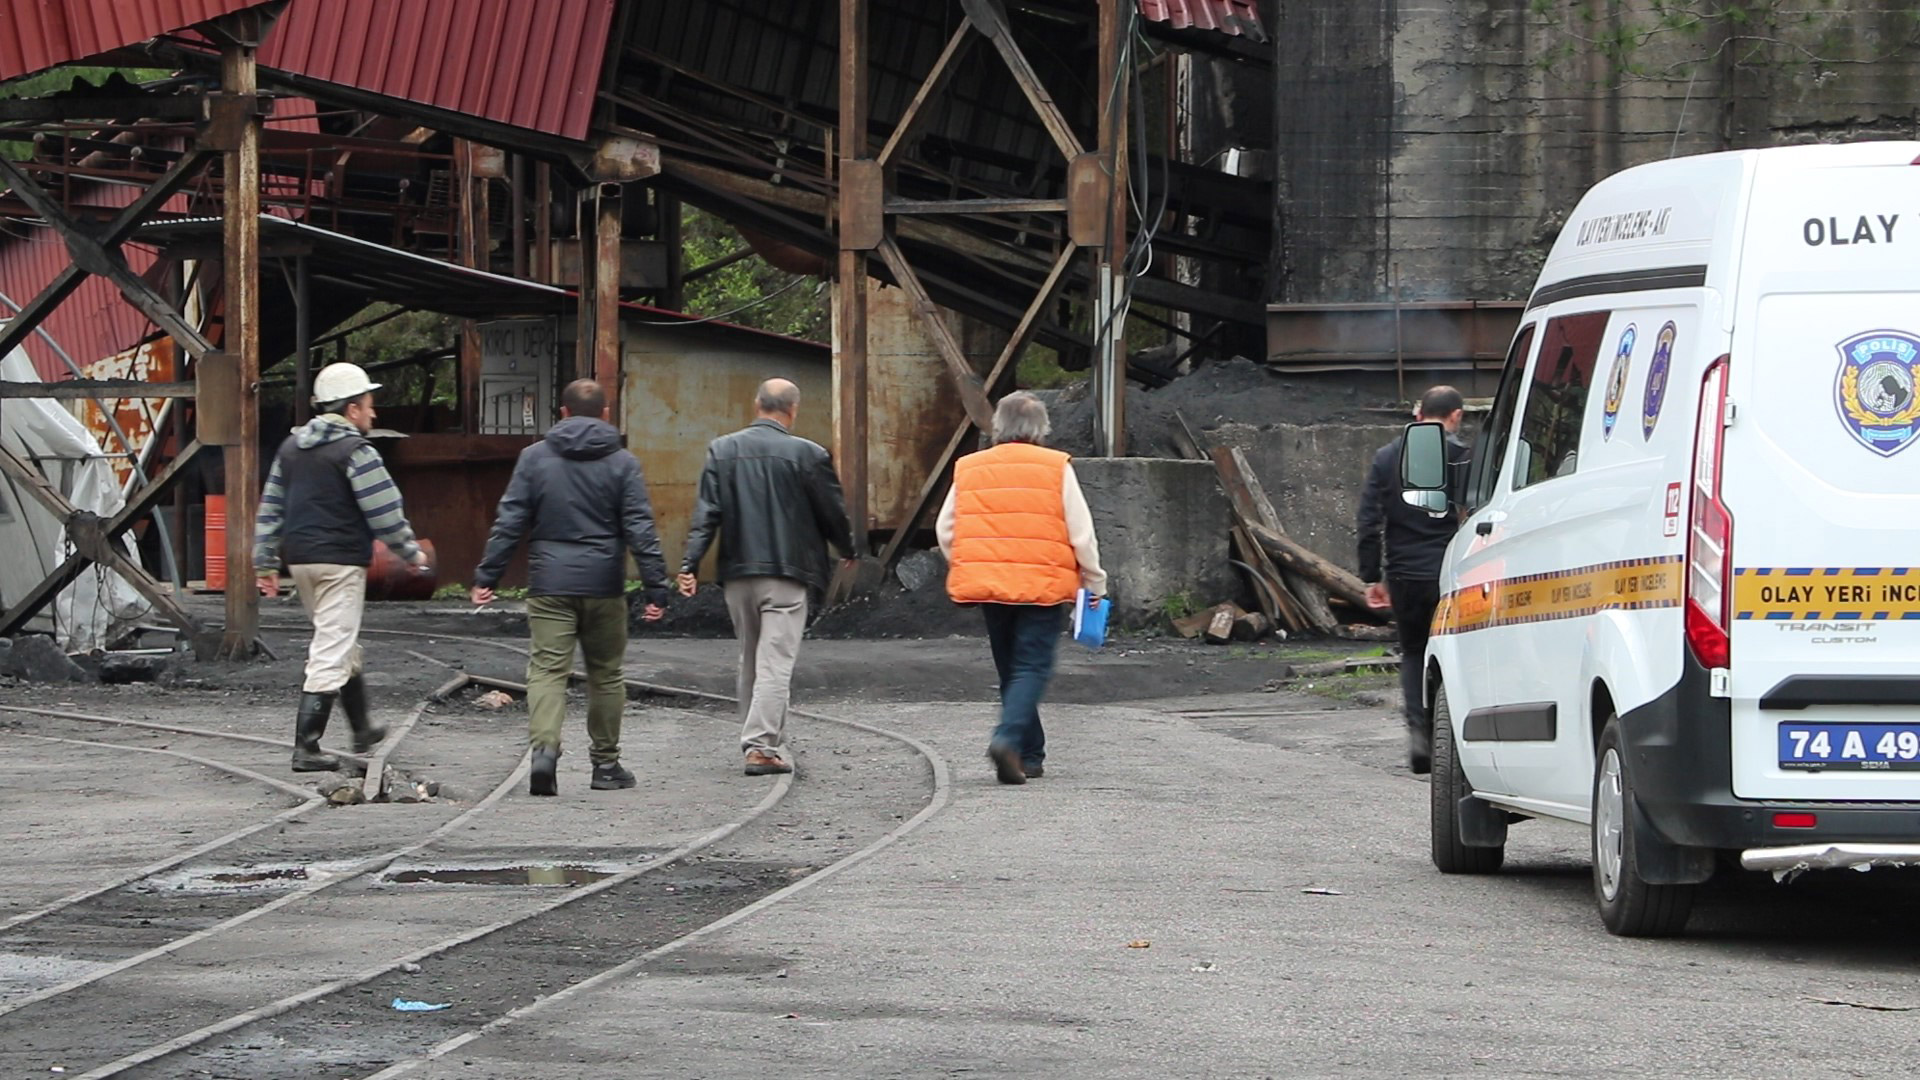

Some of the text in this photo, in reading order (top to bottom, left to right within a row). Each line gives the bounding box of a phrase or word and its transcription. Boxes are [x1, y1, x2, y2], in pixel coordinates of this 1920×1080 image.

[1803, 214, 1899, 246] OLAY
[1761, 586, 1814, 603] OLAY
[1775, 622, 1876, 632] TRANSIT
[1811, 636, 1878, 644] CUSTOM
[1789, 730, 1920, 760] 74 A 49
